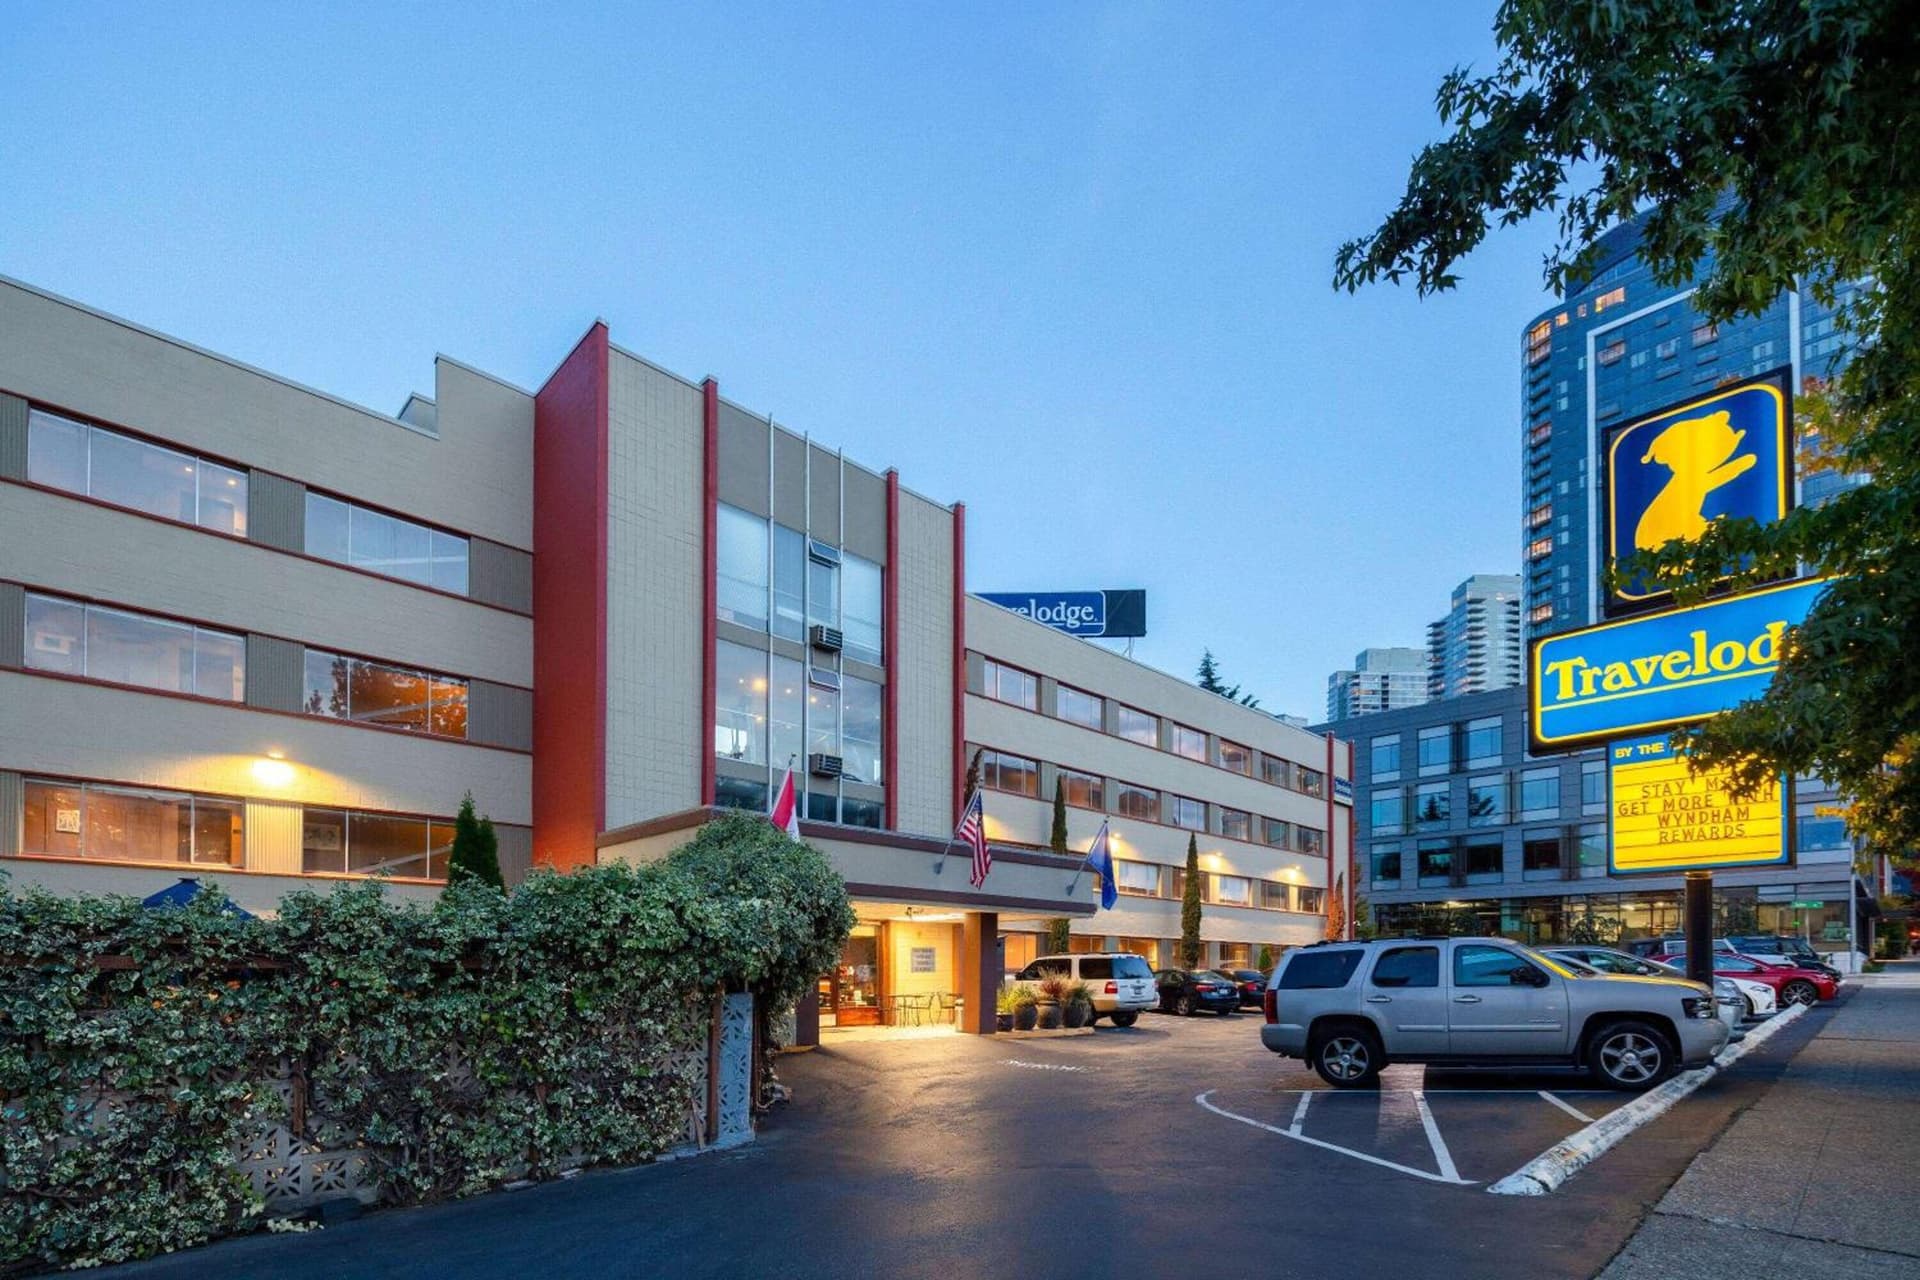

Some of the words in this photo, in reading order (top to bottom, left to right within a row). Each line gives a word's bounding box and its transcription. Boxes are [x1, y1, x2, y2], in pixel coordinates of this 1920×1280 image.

[1545, 620, 1787, 700] Travelod
[1615, 746, 1633, 758] BY
[1637, 742, 1665, 755] THE
[1642, 781, 1688, 799] STAY
[1618, 801, 1649, 817] GET
[1664, 794, 1713, 812] MORE
[1658, 806, 1750, 828] WYNDHAM
[1659, 823, 1746, 844] REWARDS
